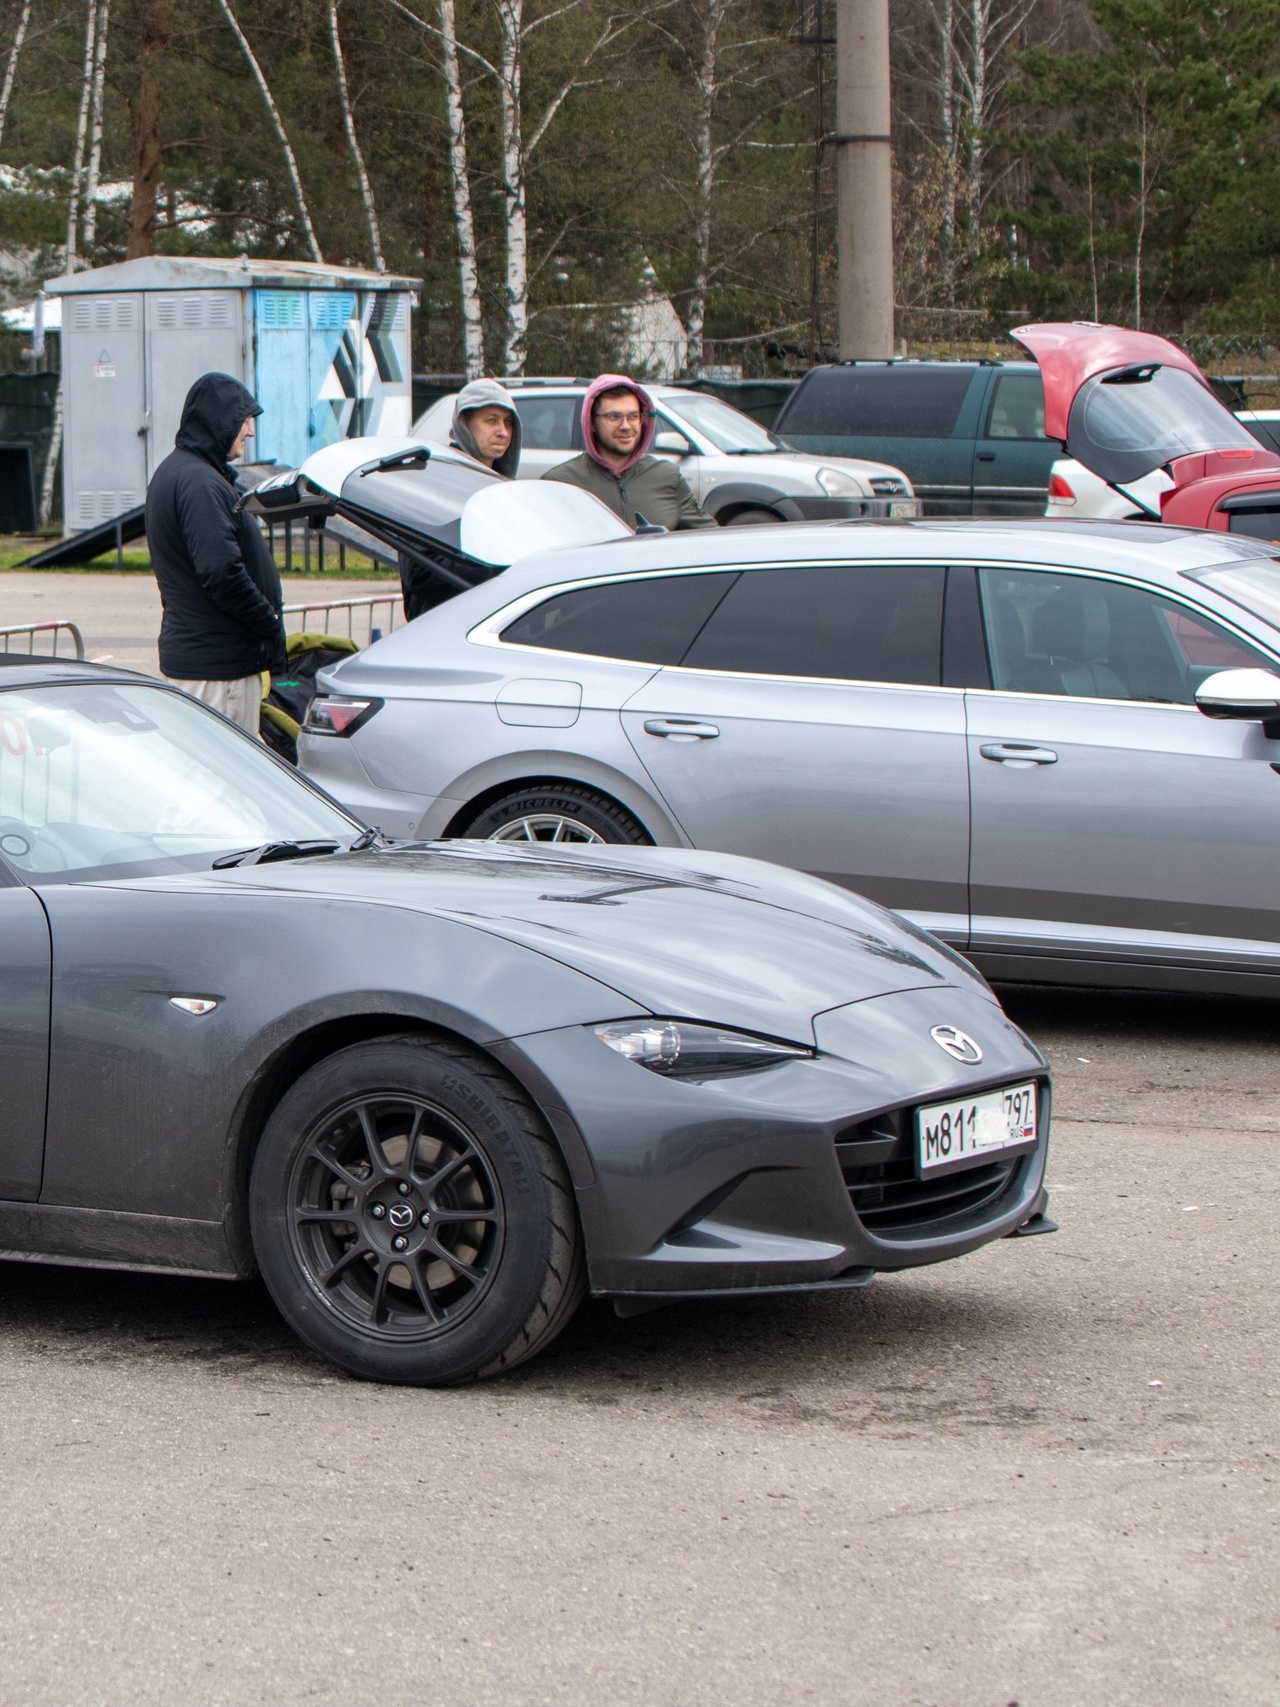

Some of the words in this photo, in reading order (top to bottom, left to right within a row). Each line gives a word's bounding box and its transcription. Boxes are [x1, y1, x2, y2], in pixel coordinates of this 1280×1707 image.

[508, 799, 577, 813] MICHELIN
[1005, 1090, 1030, 1127] 797
[1010, 1126, 1023, 1139] RUS
